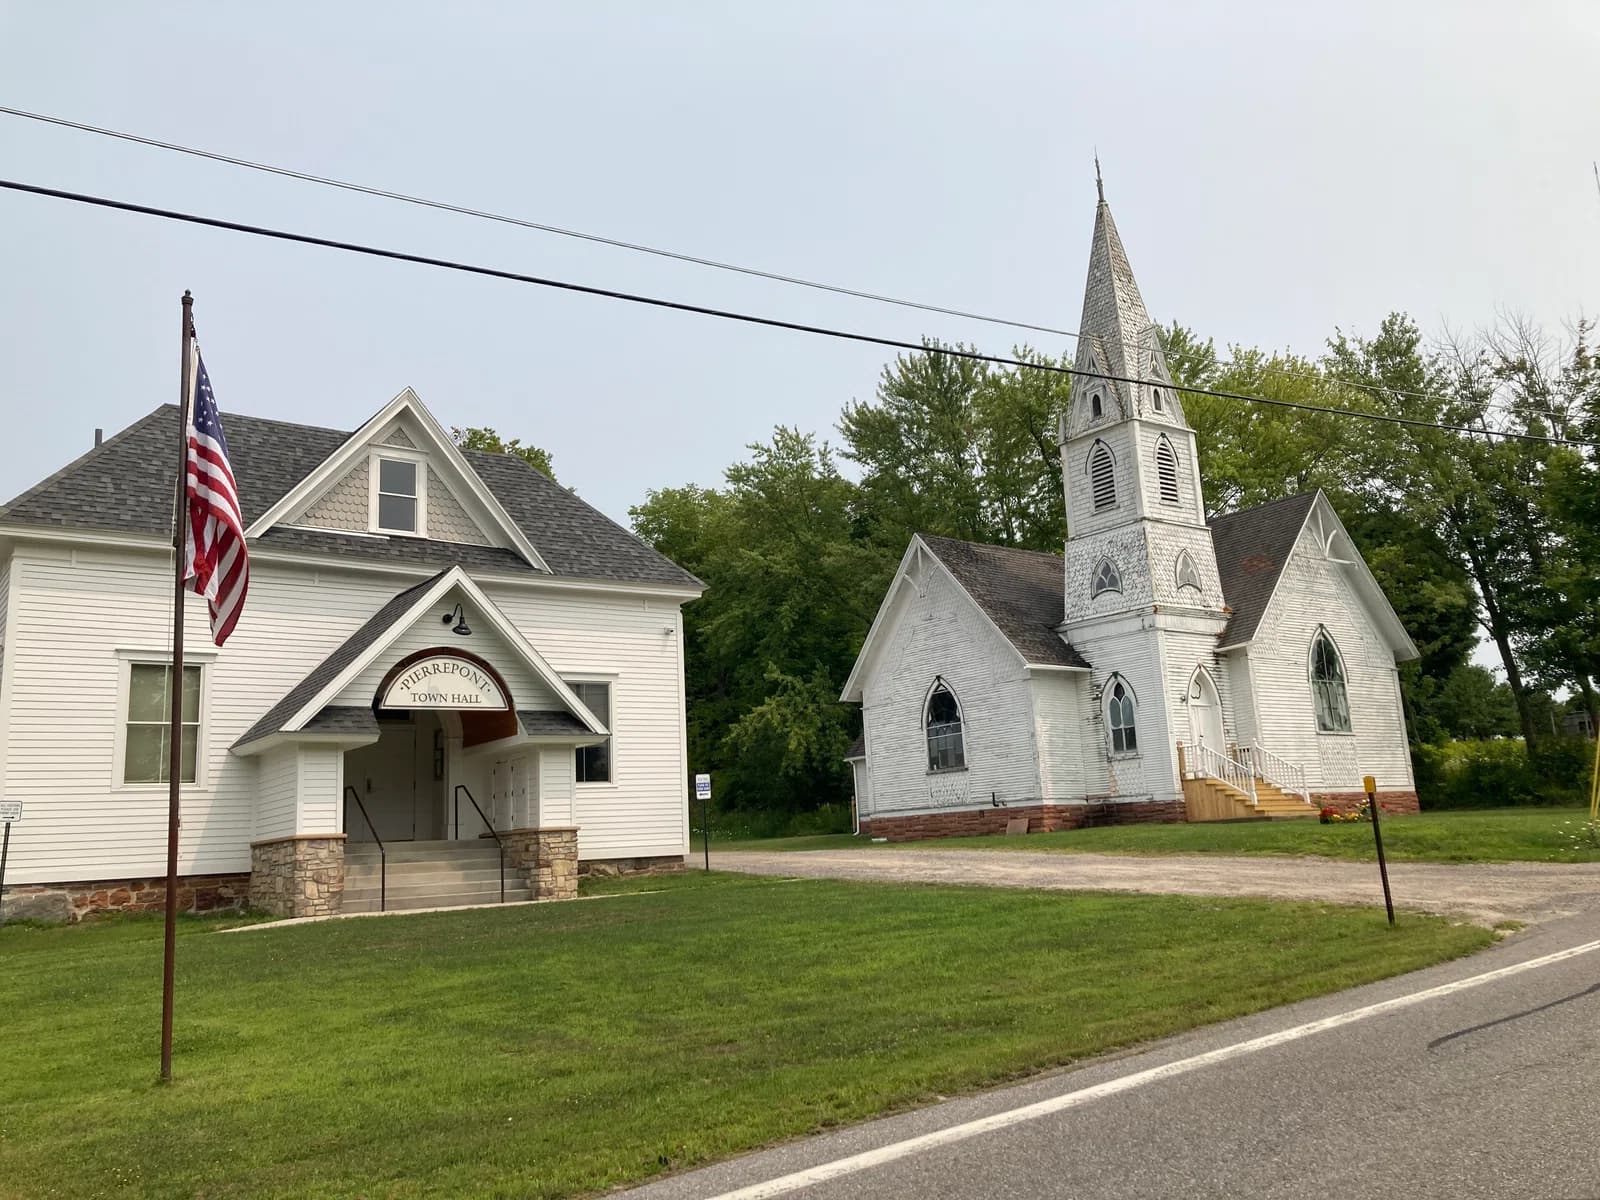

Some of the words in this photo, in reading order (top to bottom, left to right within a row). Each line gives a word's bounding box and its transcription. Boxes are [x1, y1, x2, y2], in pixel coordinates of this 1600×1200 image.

[401, 662, 490, 691] PIERREPONT
[411, 693, 448, 703] TOWN
[451, 694, 481, 704] HALL
